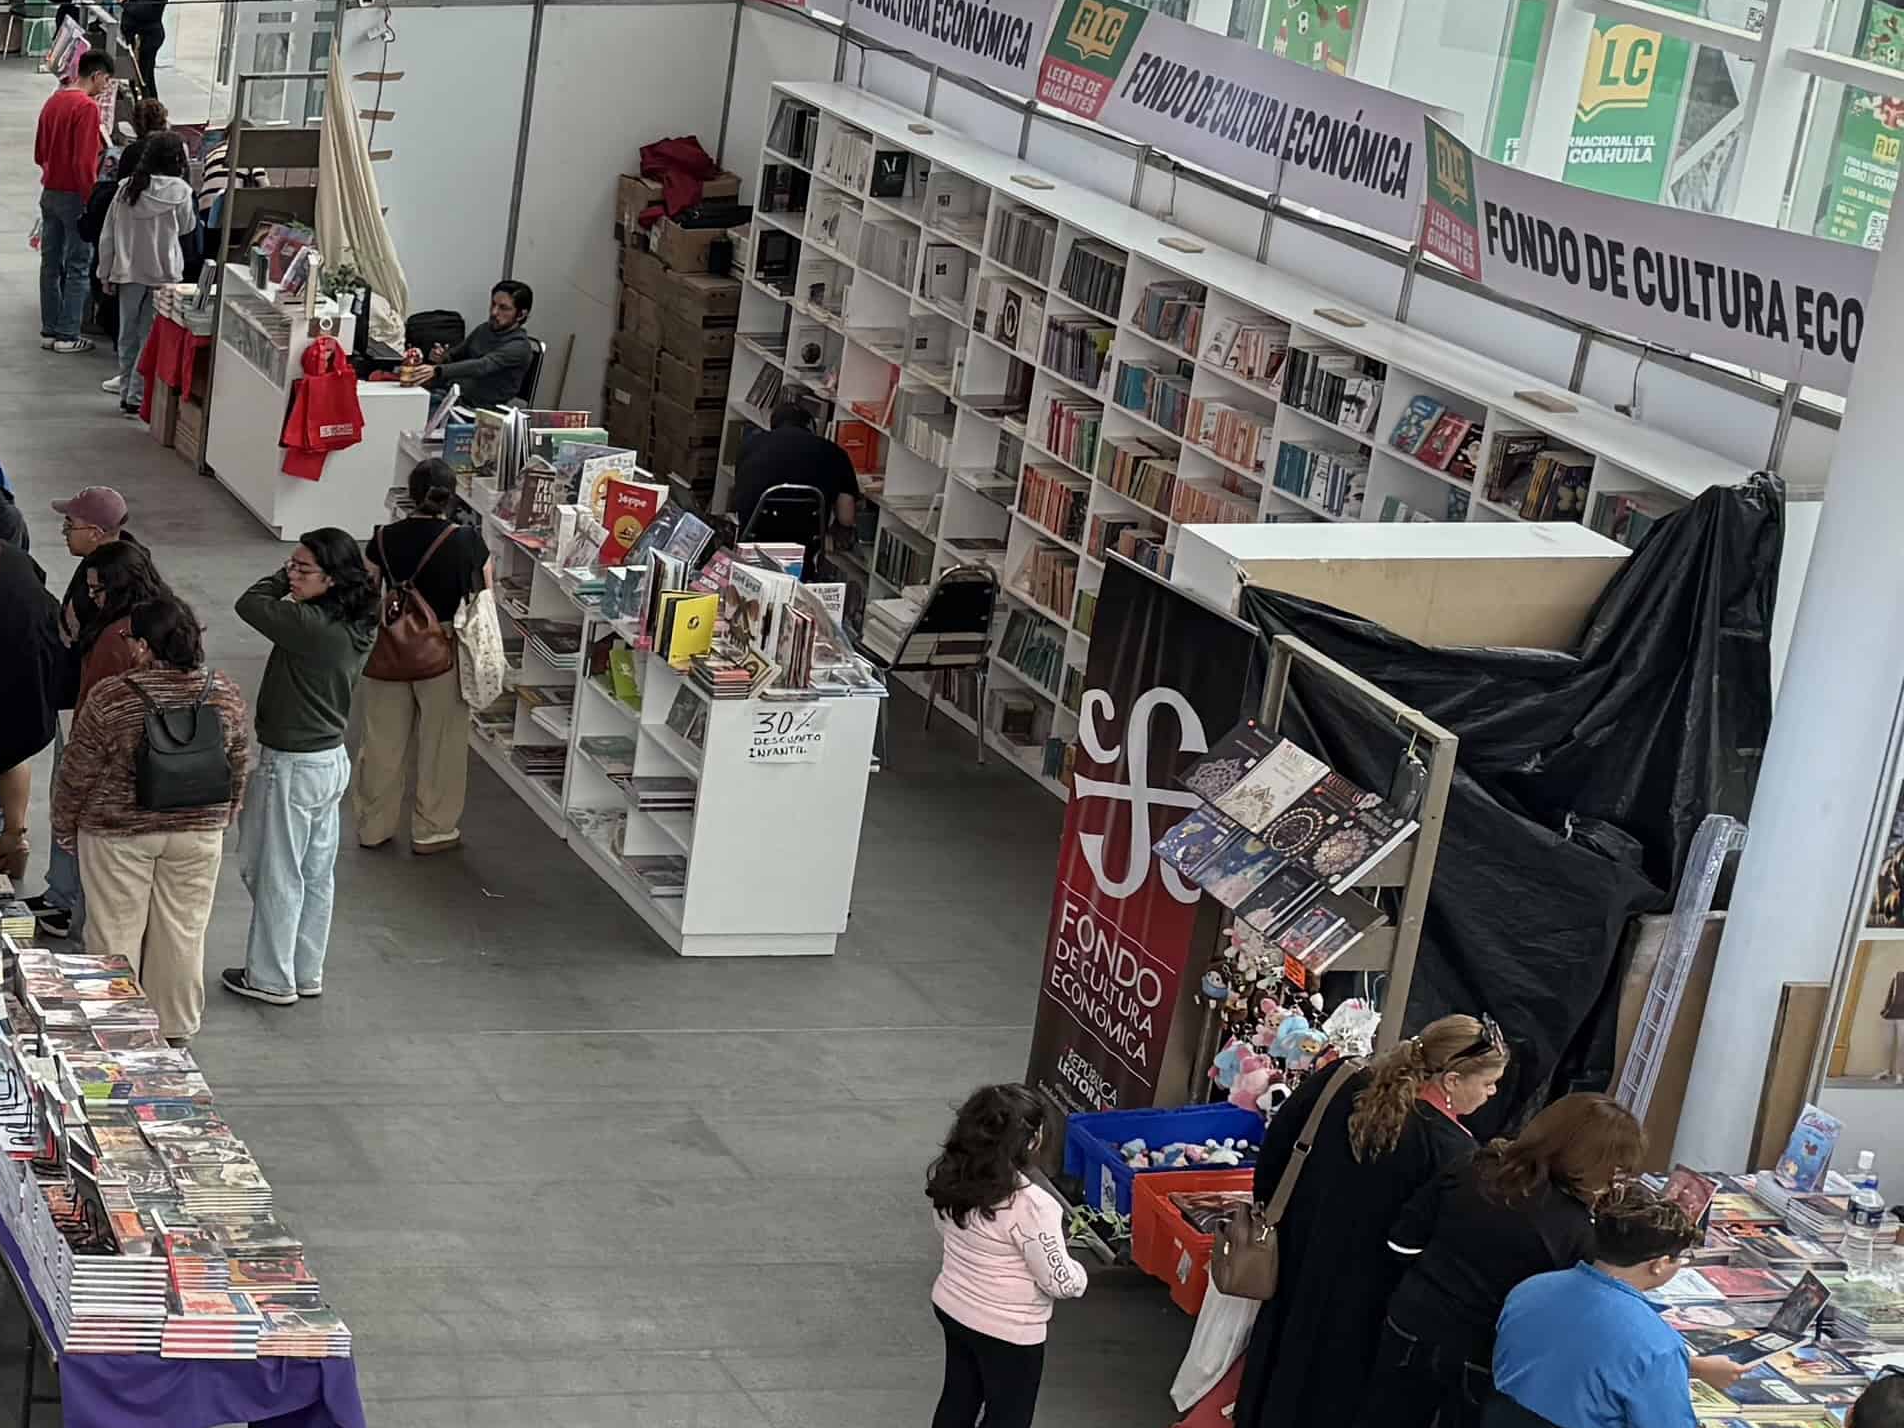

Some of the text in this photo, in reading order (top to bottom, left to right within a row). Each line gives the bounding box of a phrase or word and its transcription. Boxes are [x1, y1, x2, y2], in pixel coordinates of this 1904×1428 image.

[1120, 52, 1200, 120] FONDO
[1209, 81, 1288, 157] CULTURA
[1281, 109, 1412, 199] ECONÓMICA
[1568, 147, 1653, 164] COAHUILA
[1634, 136, 1656, 147] DEL
[1484, 200, 1579, 285] FONDO
[1584, 232, 1628, 300] DE
[1633, 246, 1790, 343] CULTURA
[756, 709, 817, 734] 30%
[1056, 938, 1154, 1039] DE CULTURA
[1060, 898, 1162, 1009] FONDO
[1050, 965, 1147, 1068] ECONÓMICA
[1056, 1054, 1104, 1111] LECTORA
